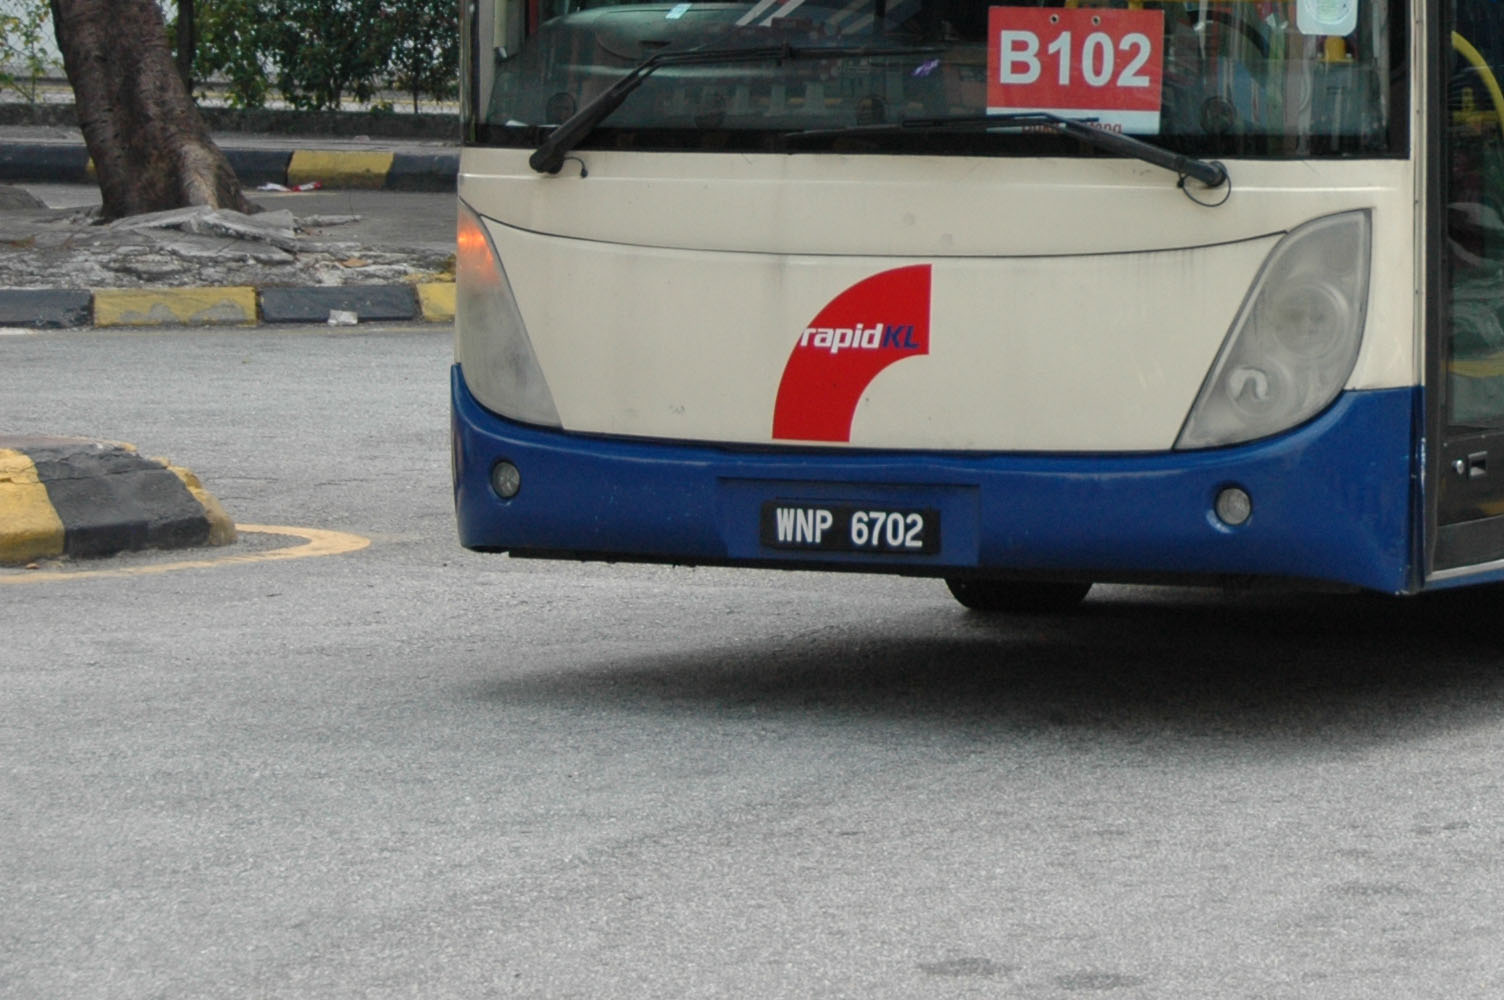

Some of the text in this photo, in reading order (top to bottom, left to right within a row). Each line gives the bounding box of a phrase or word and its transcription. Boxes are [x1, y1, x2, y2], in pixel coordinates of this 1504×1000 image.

[1000, 29, 1152, 88] B102
[800, 323, 920, 354] rapidKL
[776, 507, 924, 548] WNP 6702
